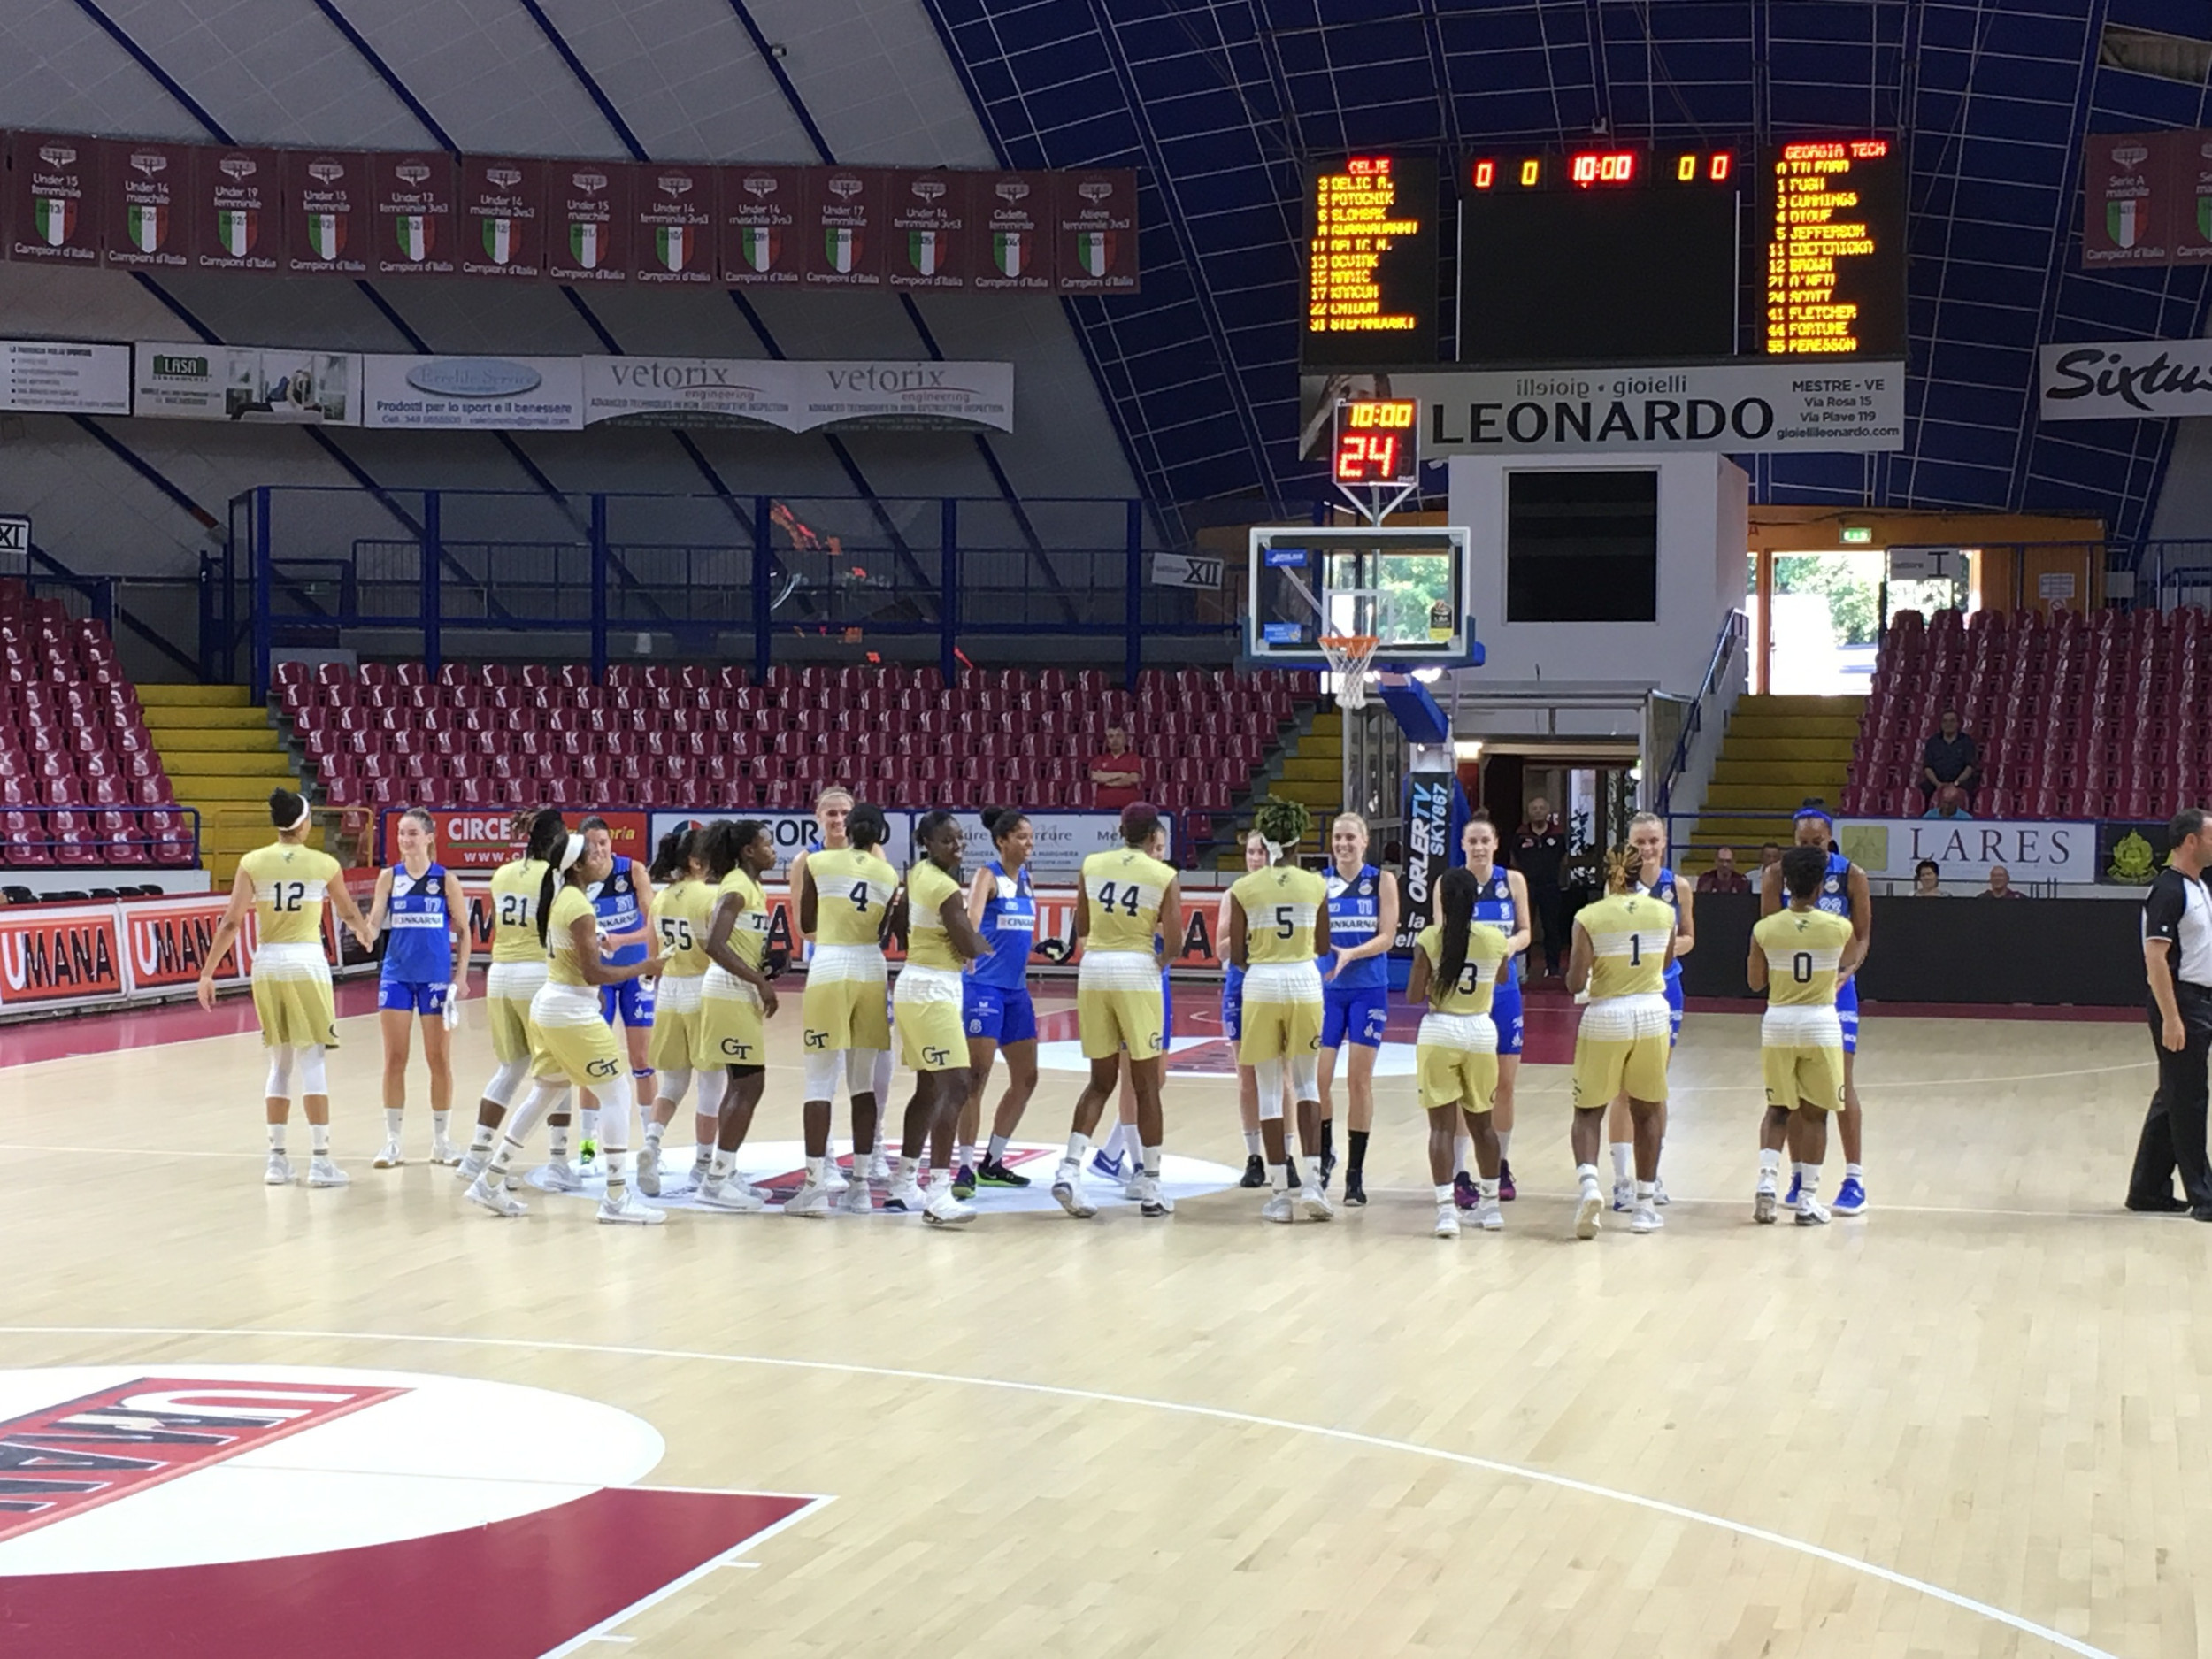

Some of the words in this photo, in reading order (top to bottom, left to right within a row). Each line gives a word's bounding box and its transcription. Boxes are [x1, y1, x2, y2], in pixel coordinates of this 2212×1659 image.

[1785, 144, 1845, 160] GEORGIA
[1850, 142, 1886, 157] TECH
[1521, 161, 1538, 185] 0
[1573, 156, 1632, 180] 10:00
[1678, 157, 1694, 180] 0
[1710, 156, 1728, 179] 0
[33, 173, 63, 185] Under
[66, 175, 79, 187] 15
[1476, 163, 1492, 187] 0
[125, 180, 156, 193] Under
[1318, 178, 1328, 191] 3
[1331, 177, 1371, 191] DELIC
[215, 186, 245, 197] Under
[303, 190, 334, 201] Under
[391, 193, 421, 203] Under
[480, 195, 510, 205] Under
[567, 200, 596, 211] Under
[1318, 194, 1327, 206] 5
[1776, 196, 1786, 209] 3
[653, 203, 681, 213] Under
[738, 204, 767, 214] Under
[823, 205, 851, 215] Under
[906, 208, 934, 219] Under
[1776, 211, 1786, 223] 4
[1776, 227, 1786, 240] 5
[15, 242, 61, 257] Campioni
[1769, 243, 1785, 257] 11
[2086, 250, 2132, 262] Campioni
[108, 250, 154, 264] Campioni
[199, 255, 244, 268] Campioni
[289, 258, 334, 272] Campioni
[379, 261, 423, 273] Campioni
[463, 262, 506, 275] Campioni
[1769, 259, 1786, 273] 12
[550, 266, 594, 280] Campioni
[638, 270, 681, 282] Campioni
[726, 272, 768, 284] Campioni
[807, 272, 849, 284] Campioni
[890, 274, 933, 287] Campioni
[975, 277, 1018, 289] Campioni
[1061, 278, 1104, 289] Campioni
[1311, 287, 1327, 300] 17
[1768, 323, 1786, 336] 44
[1768, 340, 1786, 353] 55
[165, 358, 196, 373] LASA
[611, 361, 729, 388] vetorix
[826, 364, 946, 391] vetorix
[2046, 349, 2212, 411] Sixtu
[1613, 375, 1686, 397] gioielli
[1792, 380, 1851, 392] MESTRE
[1864, 379, 1886, 390] VE
[685, 389, 753, 402] engineering
[902, 392, 970, 403] engineering
[1803, 397, 1824, 407] Via
[1827, 396, 1856, 406] Rosa
[1860, 396, 1872, 405] 15
[1350, 403, 1413, 427] 10:00
[1433, 399, 1774, 444] LEONARDO
[1800, 412, 1819, 423] Via
[1824, 411, 1855, 422] Piave
[1858, 411, 1877, 421] 119
[1339, 436, 1394, 477] 24
[1183, 558, 1220, 587] XII
[1909, 827, 2070, 864] LARES
[273, 882, 305, 912] 12
[850, 882, 869, 912] 4
[1099, 882, 1140, 917] 44
[424, 897, 442, 912] 17
[502, 896, 527, 927] 21
[1275, 907, 1294, 940] 5
[661, 918, 692, 950] 55
[1629, 933, 1640, 966] 1
[2, 926, 116, 991] UMANA
[1793, 952, 1812, 983] 0
[1458, 962, 1478, 995] 3
